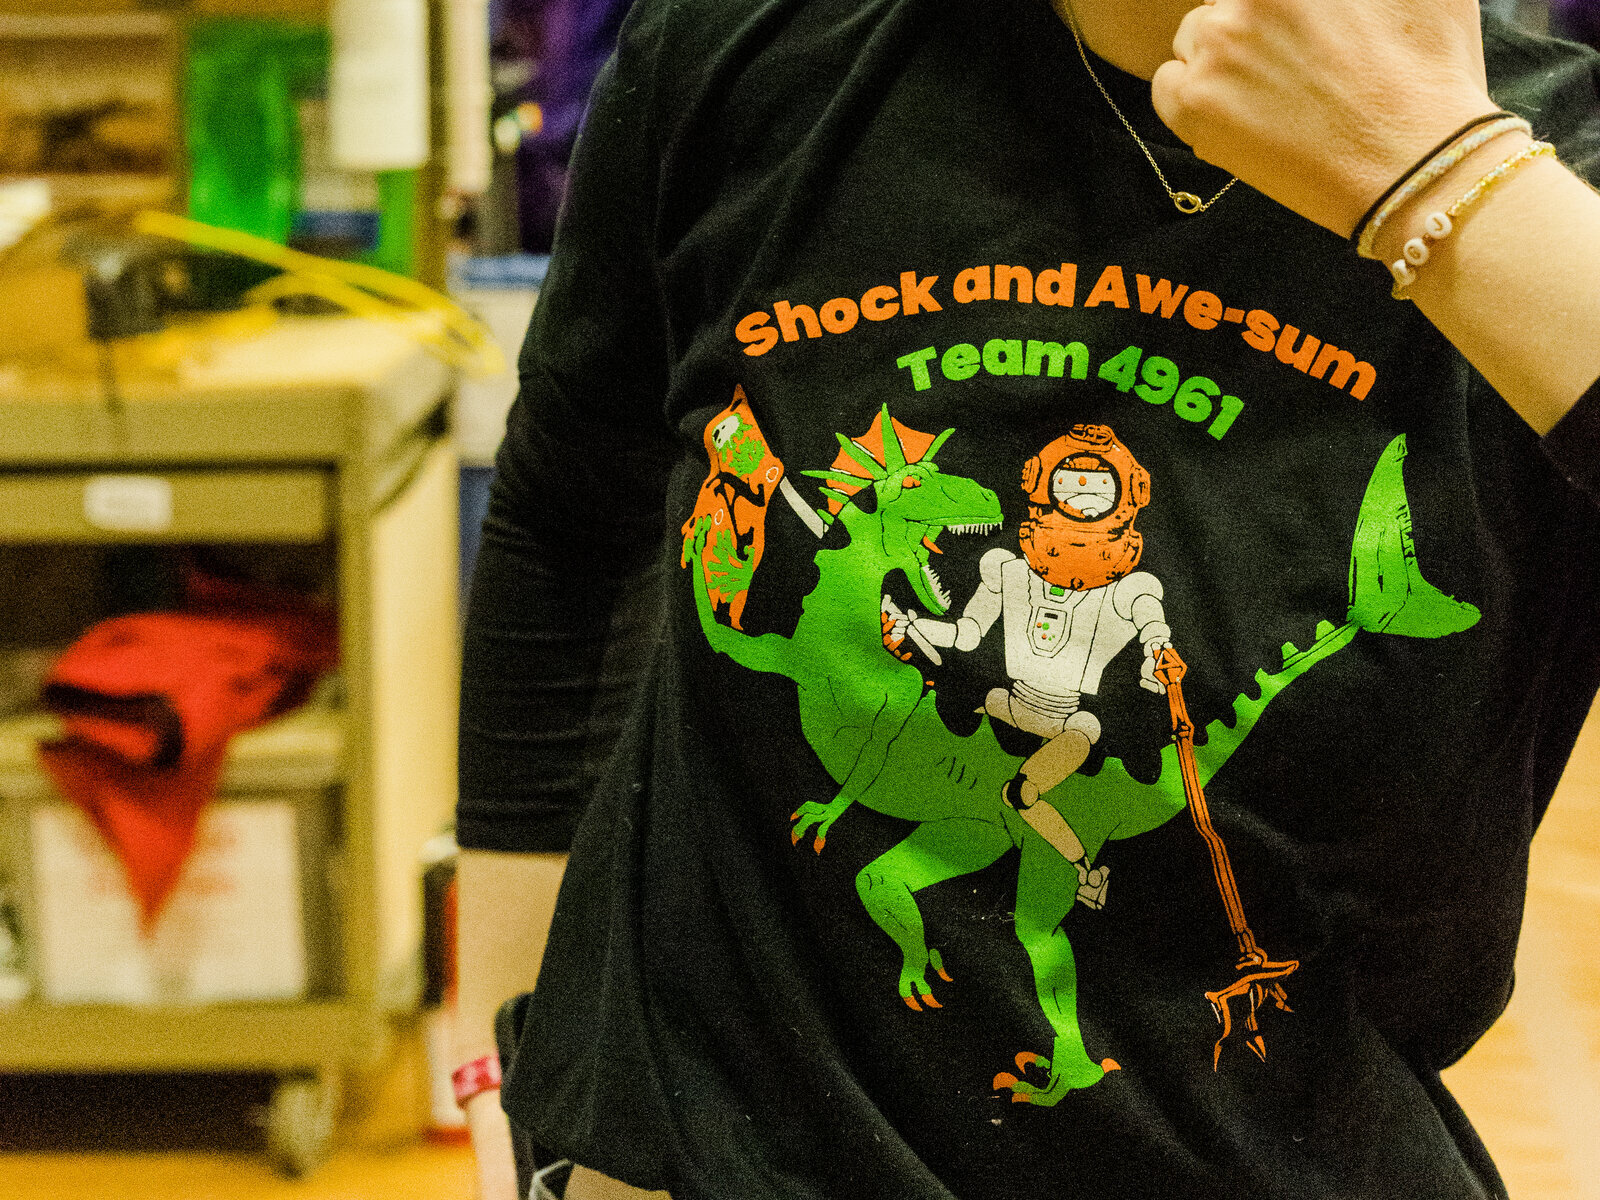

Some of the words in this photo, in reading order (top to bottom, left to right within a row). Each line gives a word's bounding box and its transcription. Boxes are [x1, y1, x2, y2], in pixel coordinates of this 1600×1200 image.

[735, 270, 942, 357] Shock
[953, 262, 1078, 308] and
[896, 338, 1090, 392] Team
[1098, 345, 1245, 440] 4961
